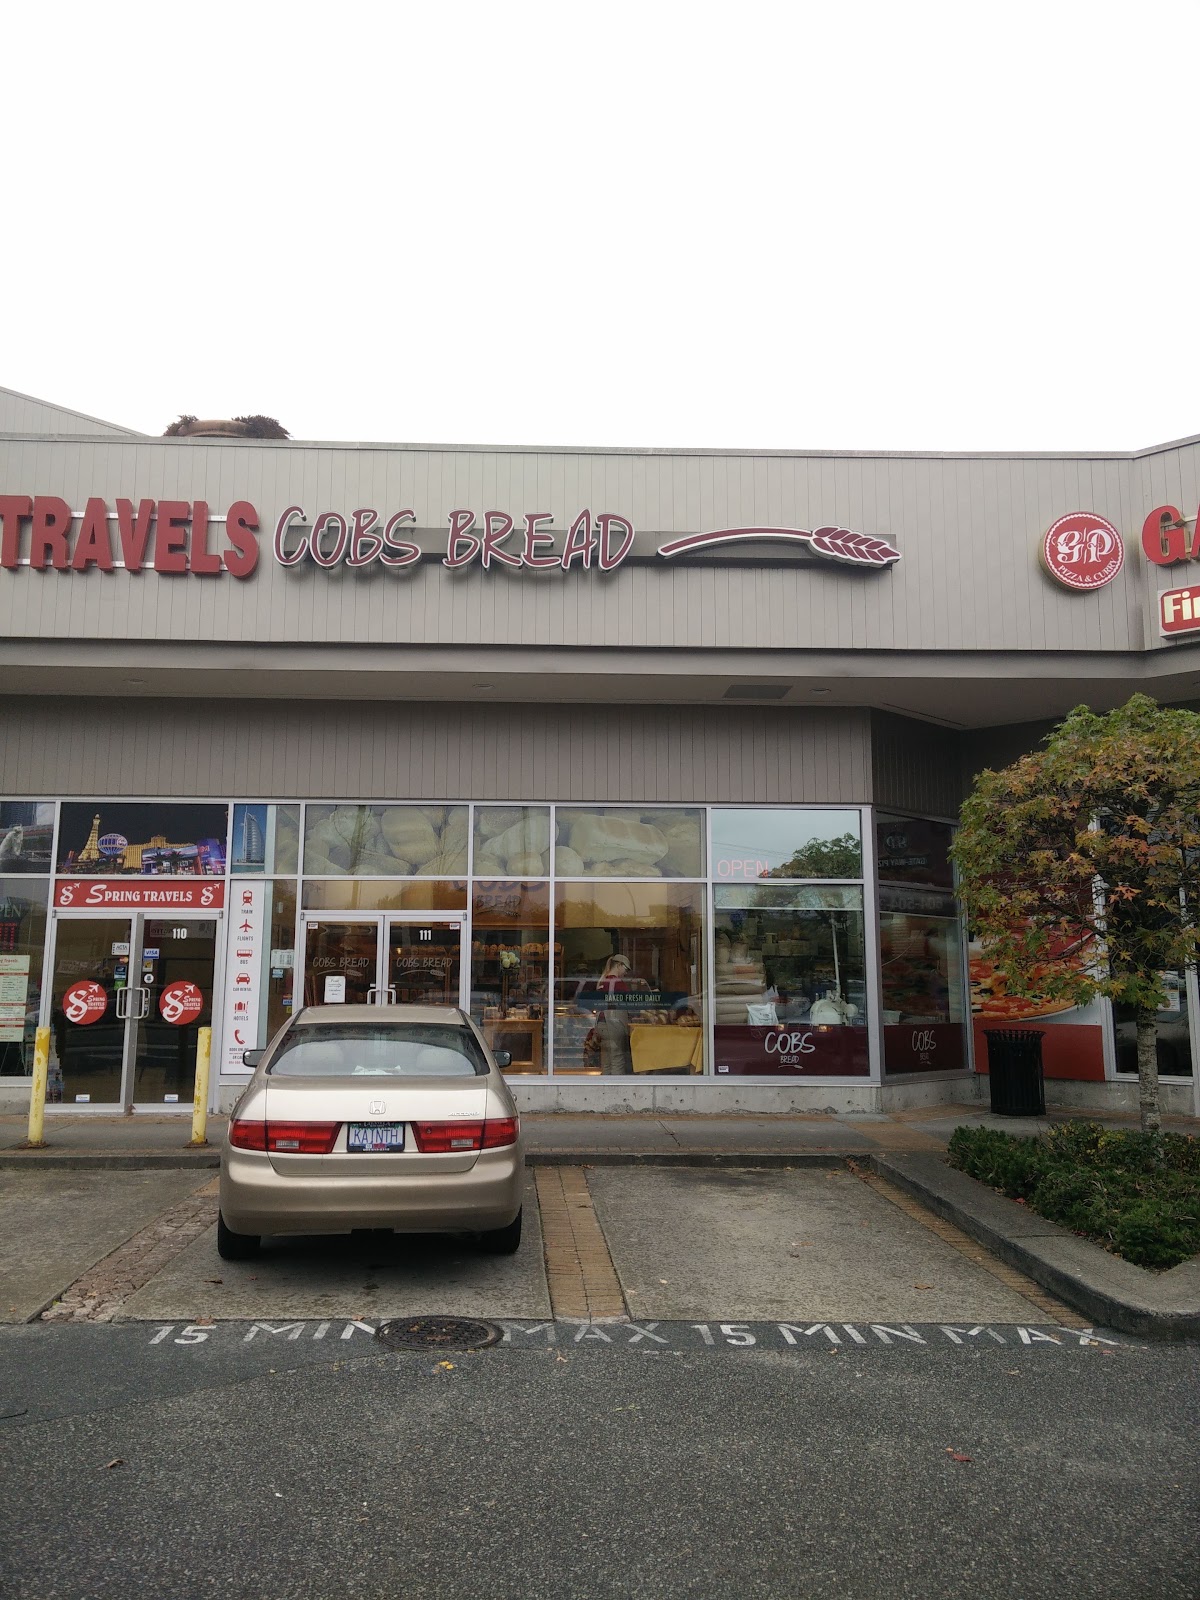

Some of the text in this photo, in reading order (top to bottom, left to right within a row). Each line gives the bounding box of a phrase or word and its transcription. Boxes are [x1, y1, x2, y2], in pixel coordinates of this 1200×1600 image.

[0, 495, 260, 579] TRAVELS
[274, 506, 635, 571] COBS BREAD
[1142, 504, 1200, 566] G
[1058, 557, 1118, 583] PIZZA & CURRY
[717, 859, 769, 877] OPEN
[85, 884, 140, 904] SPRING
[143, 890, 193, 902] TRAVELS
[172, 928, 187, 939] 110
[419, 930, 432, 941] 111
[312, 956, 370, 968] COBS BREAD
[396, 956, 453, 968] COBS BREAD
[604, 994, 662, 1002] BAKED FRESH DAILY
[764, 1031, 816, 1054] COBS
[912, 1030, 937, 1051] COBS
[780, 1055, 800, 1064] BREAD
[148, 1325, 217, 1345] 15
[502, 1321, 671, 1344] MAX
[691, 1323, 1121, 1346] 15 MIN MAX
